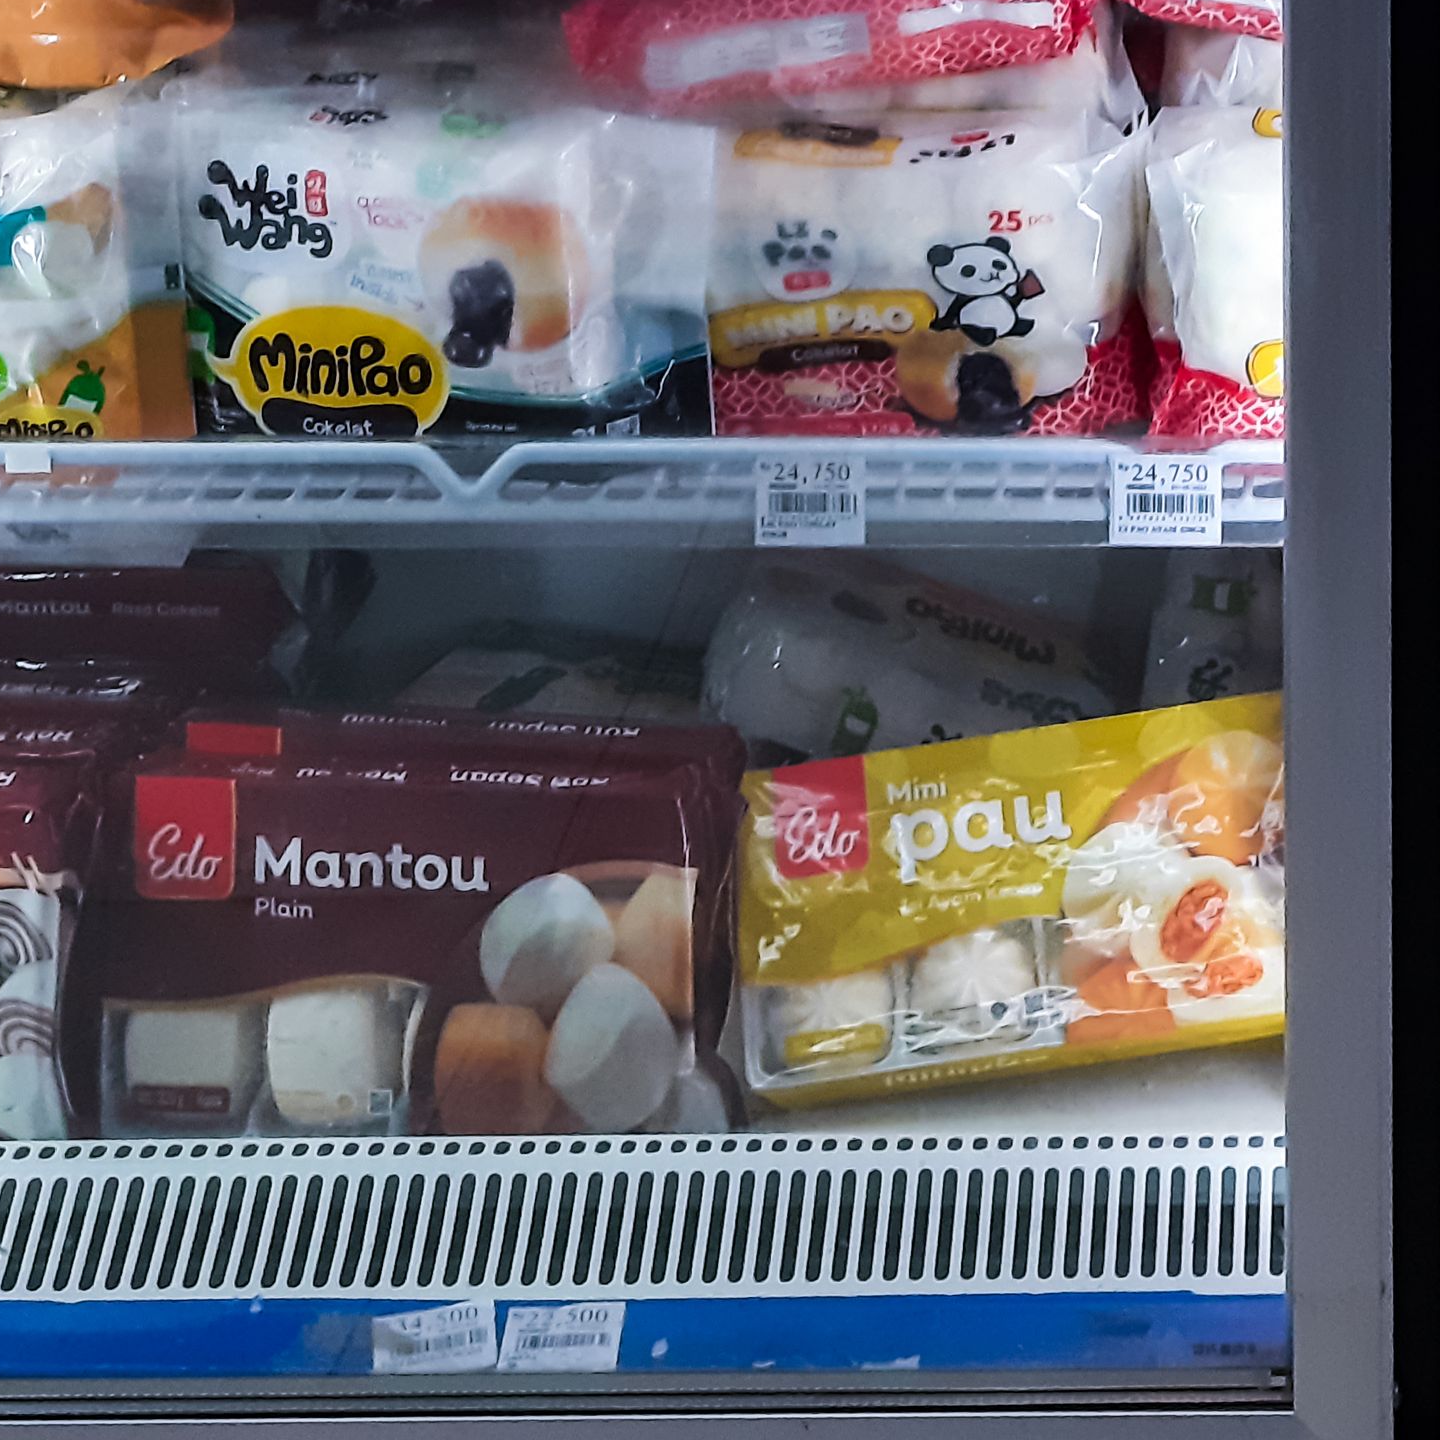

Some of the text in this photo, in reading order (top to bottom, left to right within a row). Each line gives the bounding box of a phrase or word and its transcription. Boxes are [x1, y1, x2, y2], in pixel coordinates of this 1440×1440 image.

[206, 160, 298, 215] Wei
[198, 195, 334, 259] Wang
[988, 210, 1023, 232] 25
[247, 332, 433, 399] MiniPao
[302, 416, 374, 438] Cokelat
[774, 462, 851, 485] 24,750
[1131, 463, 1209, 487] 24,750
[886, 778, 948, 804] Mini
[781, 790, 1073, 887] Edo pau
[146, 823, 489, 893] Edo Mantou
[254, 897, 314, 920] Plain
